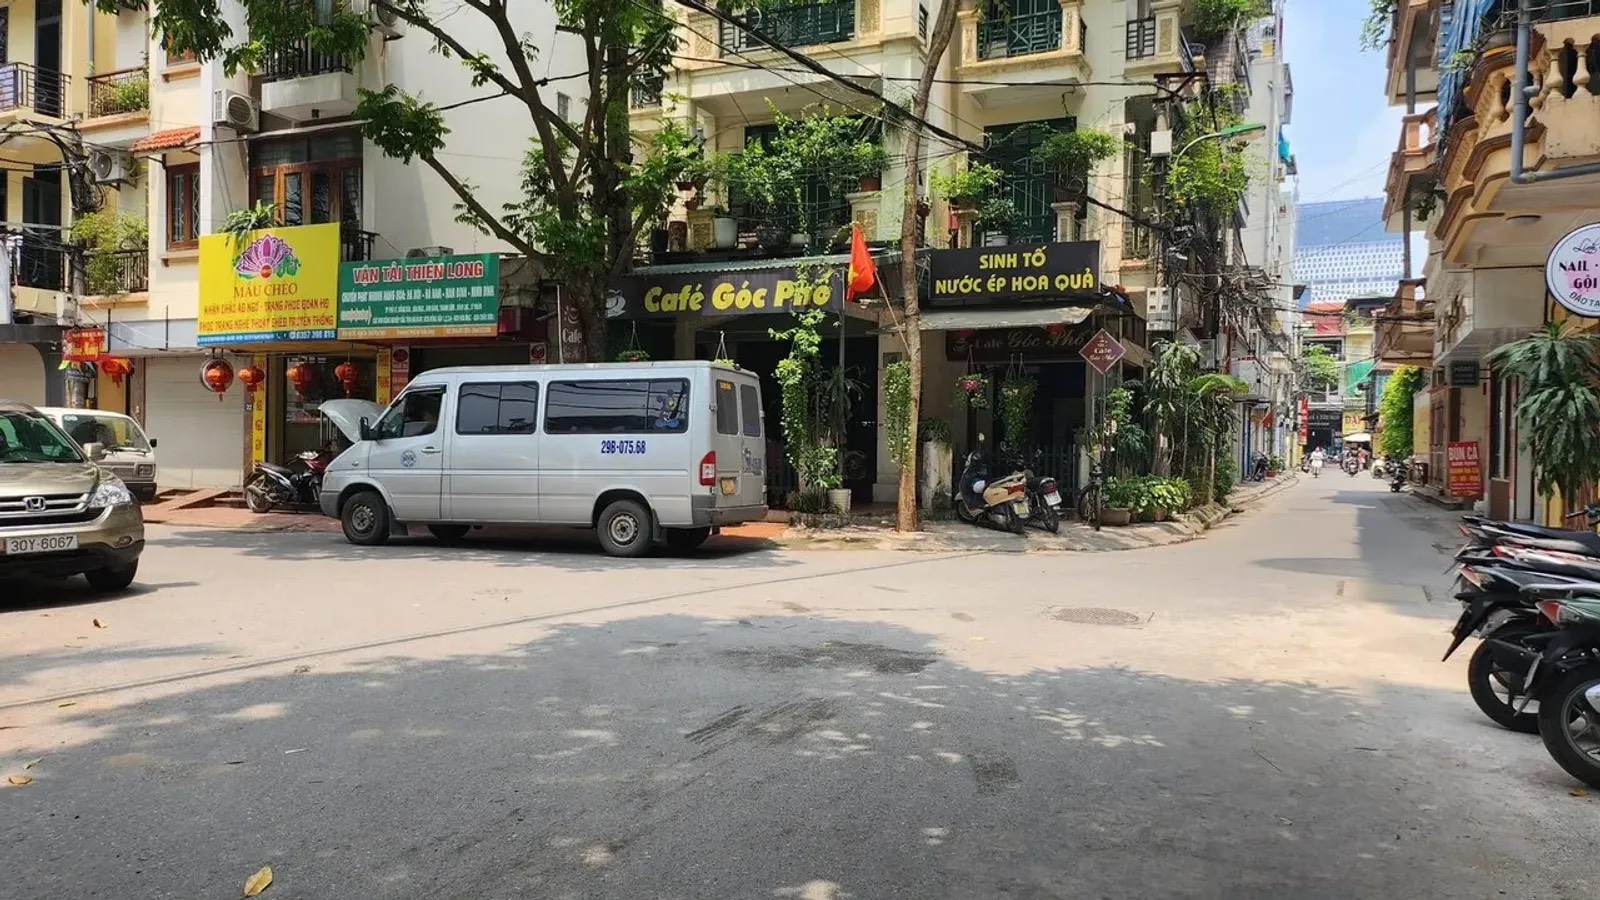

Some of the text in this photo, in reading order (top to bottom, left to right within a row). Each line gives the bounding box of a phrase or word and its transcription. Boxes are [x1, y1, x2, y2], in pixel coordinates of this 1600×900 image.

[979, 245, 1048, 269] SINH TỐ
[1559, 260, 1590, 272] NAIL
[353, 264, 379, 286] VẬN
[405, 260, 444, 283] THIỆN
[447, 261, 483, 279] LONG
[935, 267, 1094, 294] NƯỚC ÉP HOA QUẢ
[1574, 274, 1598, 292] GỘI
[644, 283, 705, 313] Café
[711, 280, 768, 310] Góc
